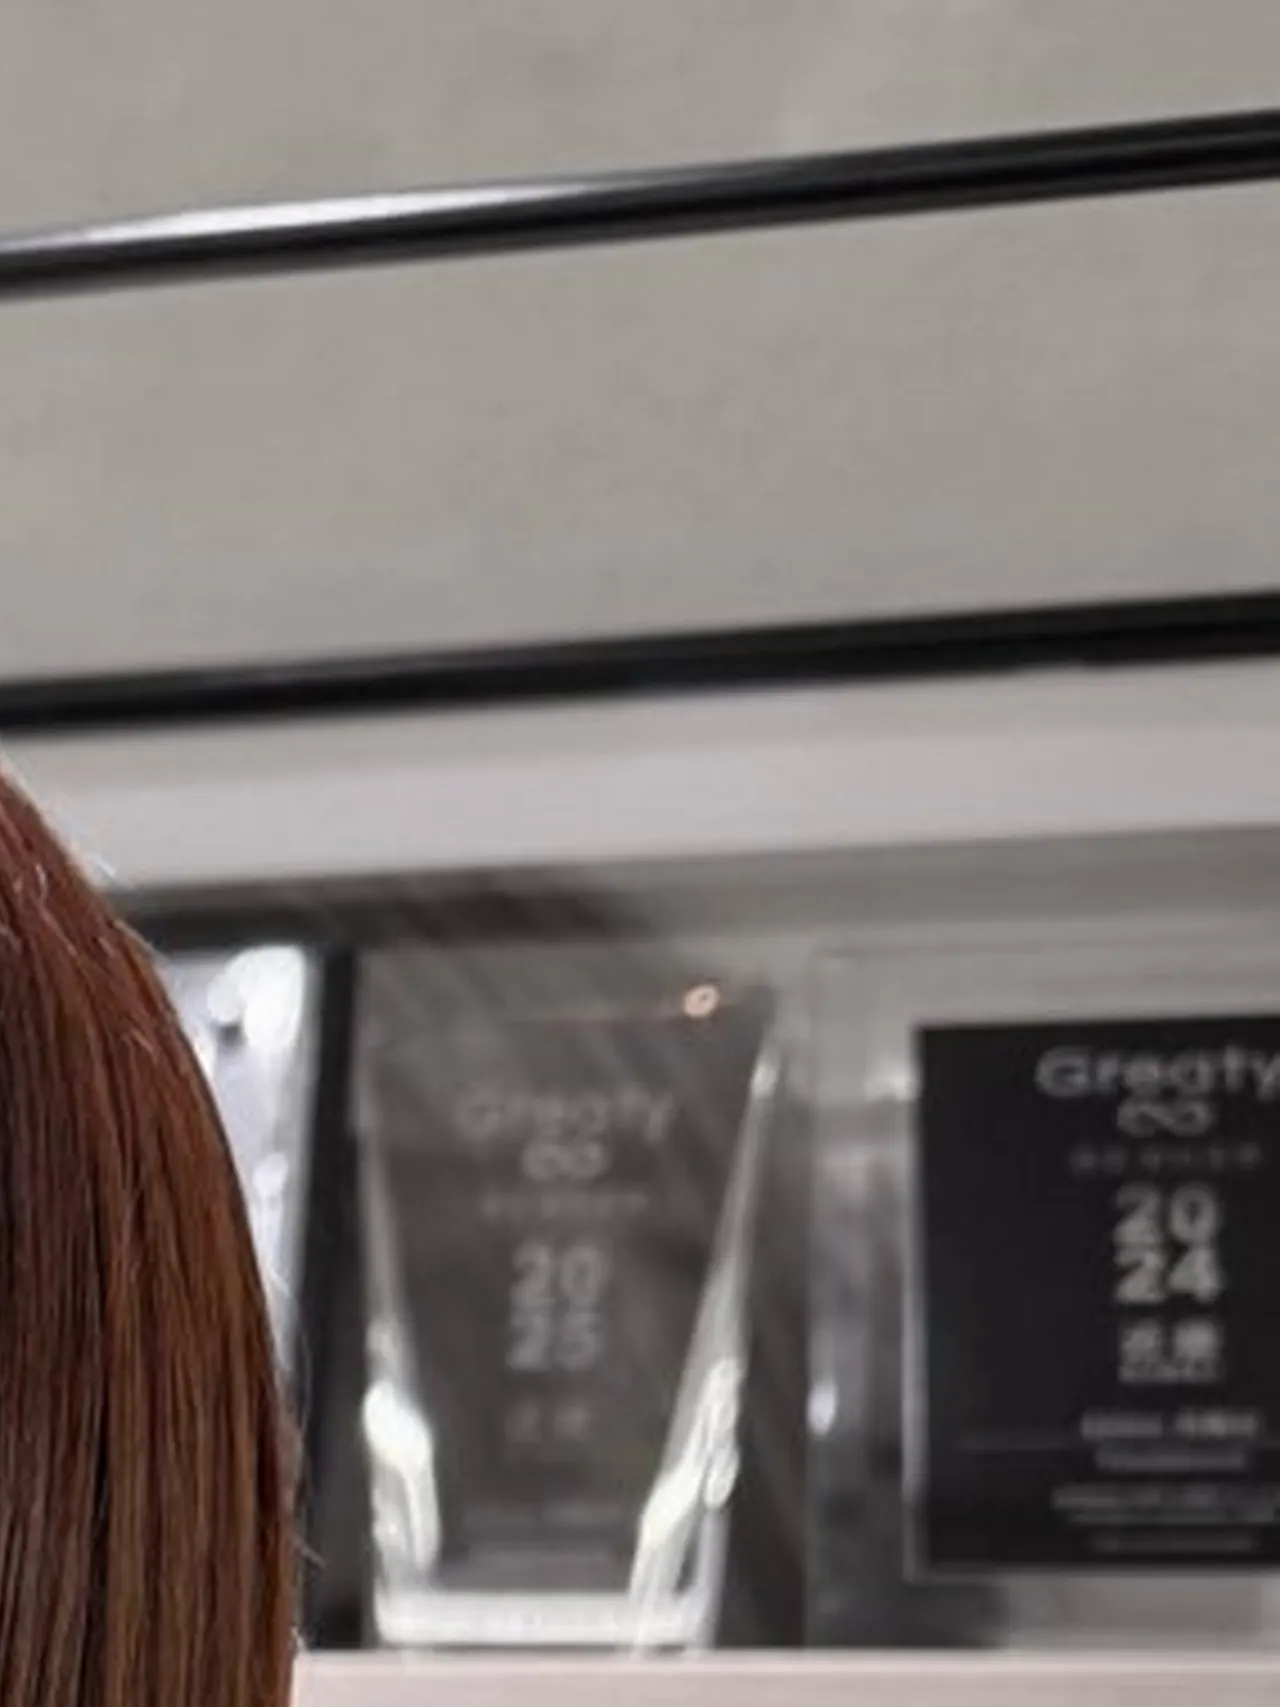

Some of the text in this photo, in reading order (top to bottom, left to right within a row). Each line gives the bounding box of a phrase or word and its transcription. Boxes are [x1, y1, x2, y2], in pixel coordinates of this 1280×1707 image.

[1115, 1183, 1220, 1243] 20
[512, 1241, 607, 1306] 20
[1113, 1244, 1221, 1304] 24
